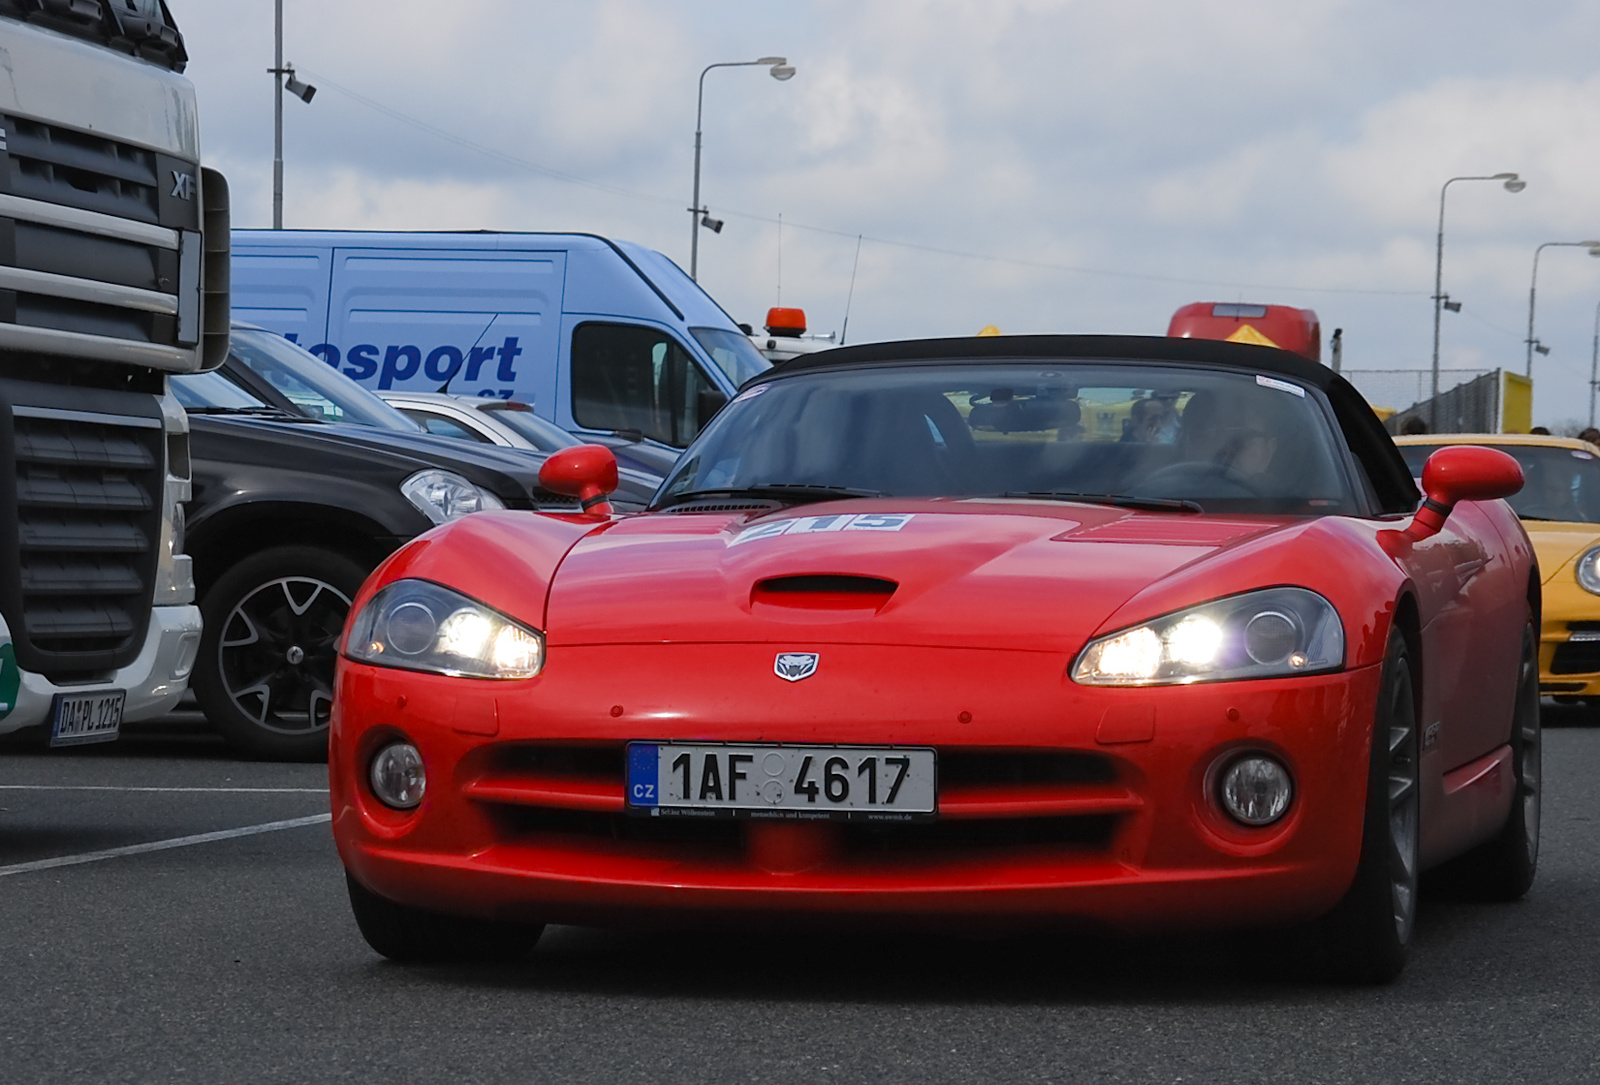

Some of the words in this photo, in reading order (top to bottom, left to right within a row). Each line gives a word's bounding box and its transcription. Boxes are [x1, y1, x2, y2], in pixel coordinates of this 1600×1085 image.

[172, 170, 195, 200] XF
[736, 514, 905, 544] 215
[95, 696, 122, 730] 1215
[634, 784, 655, 798] CZ
[672, 753, 754, 801] 1AF
[794, 755, 911, 804] 4617
